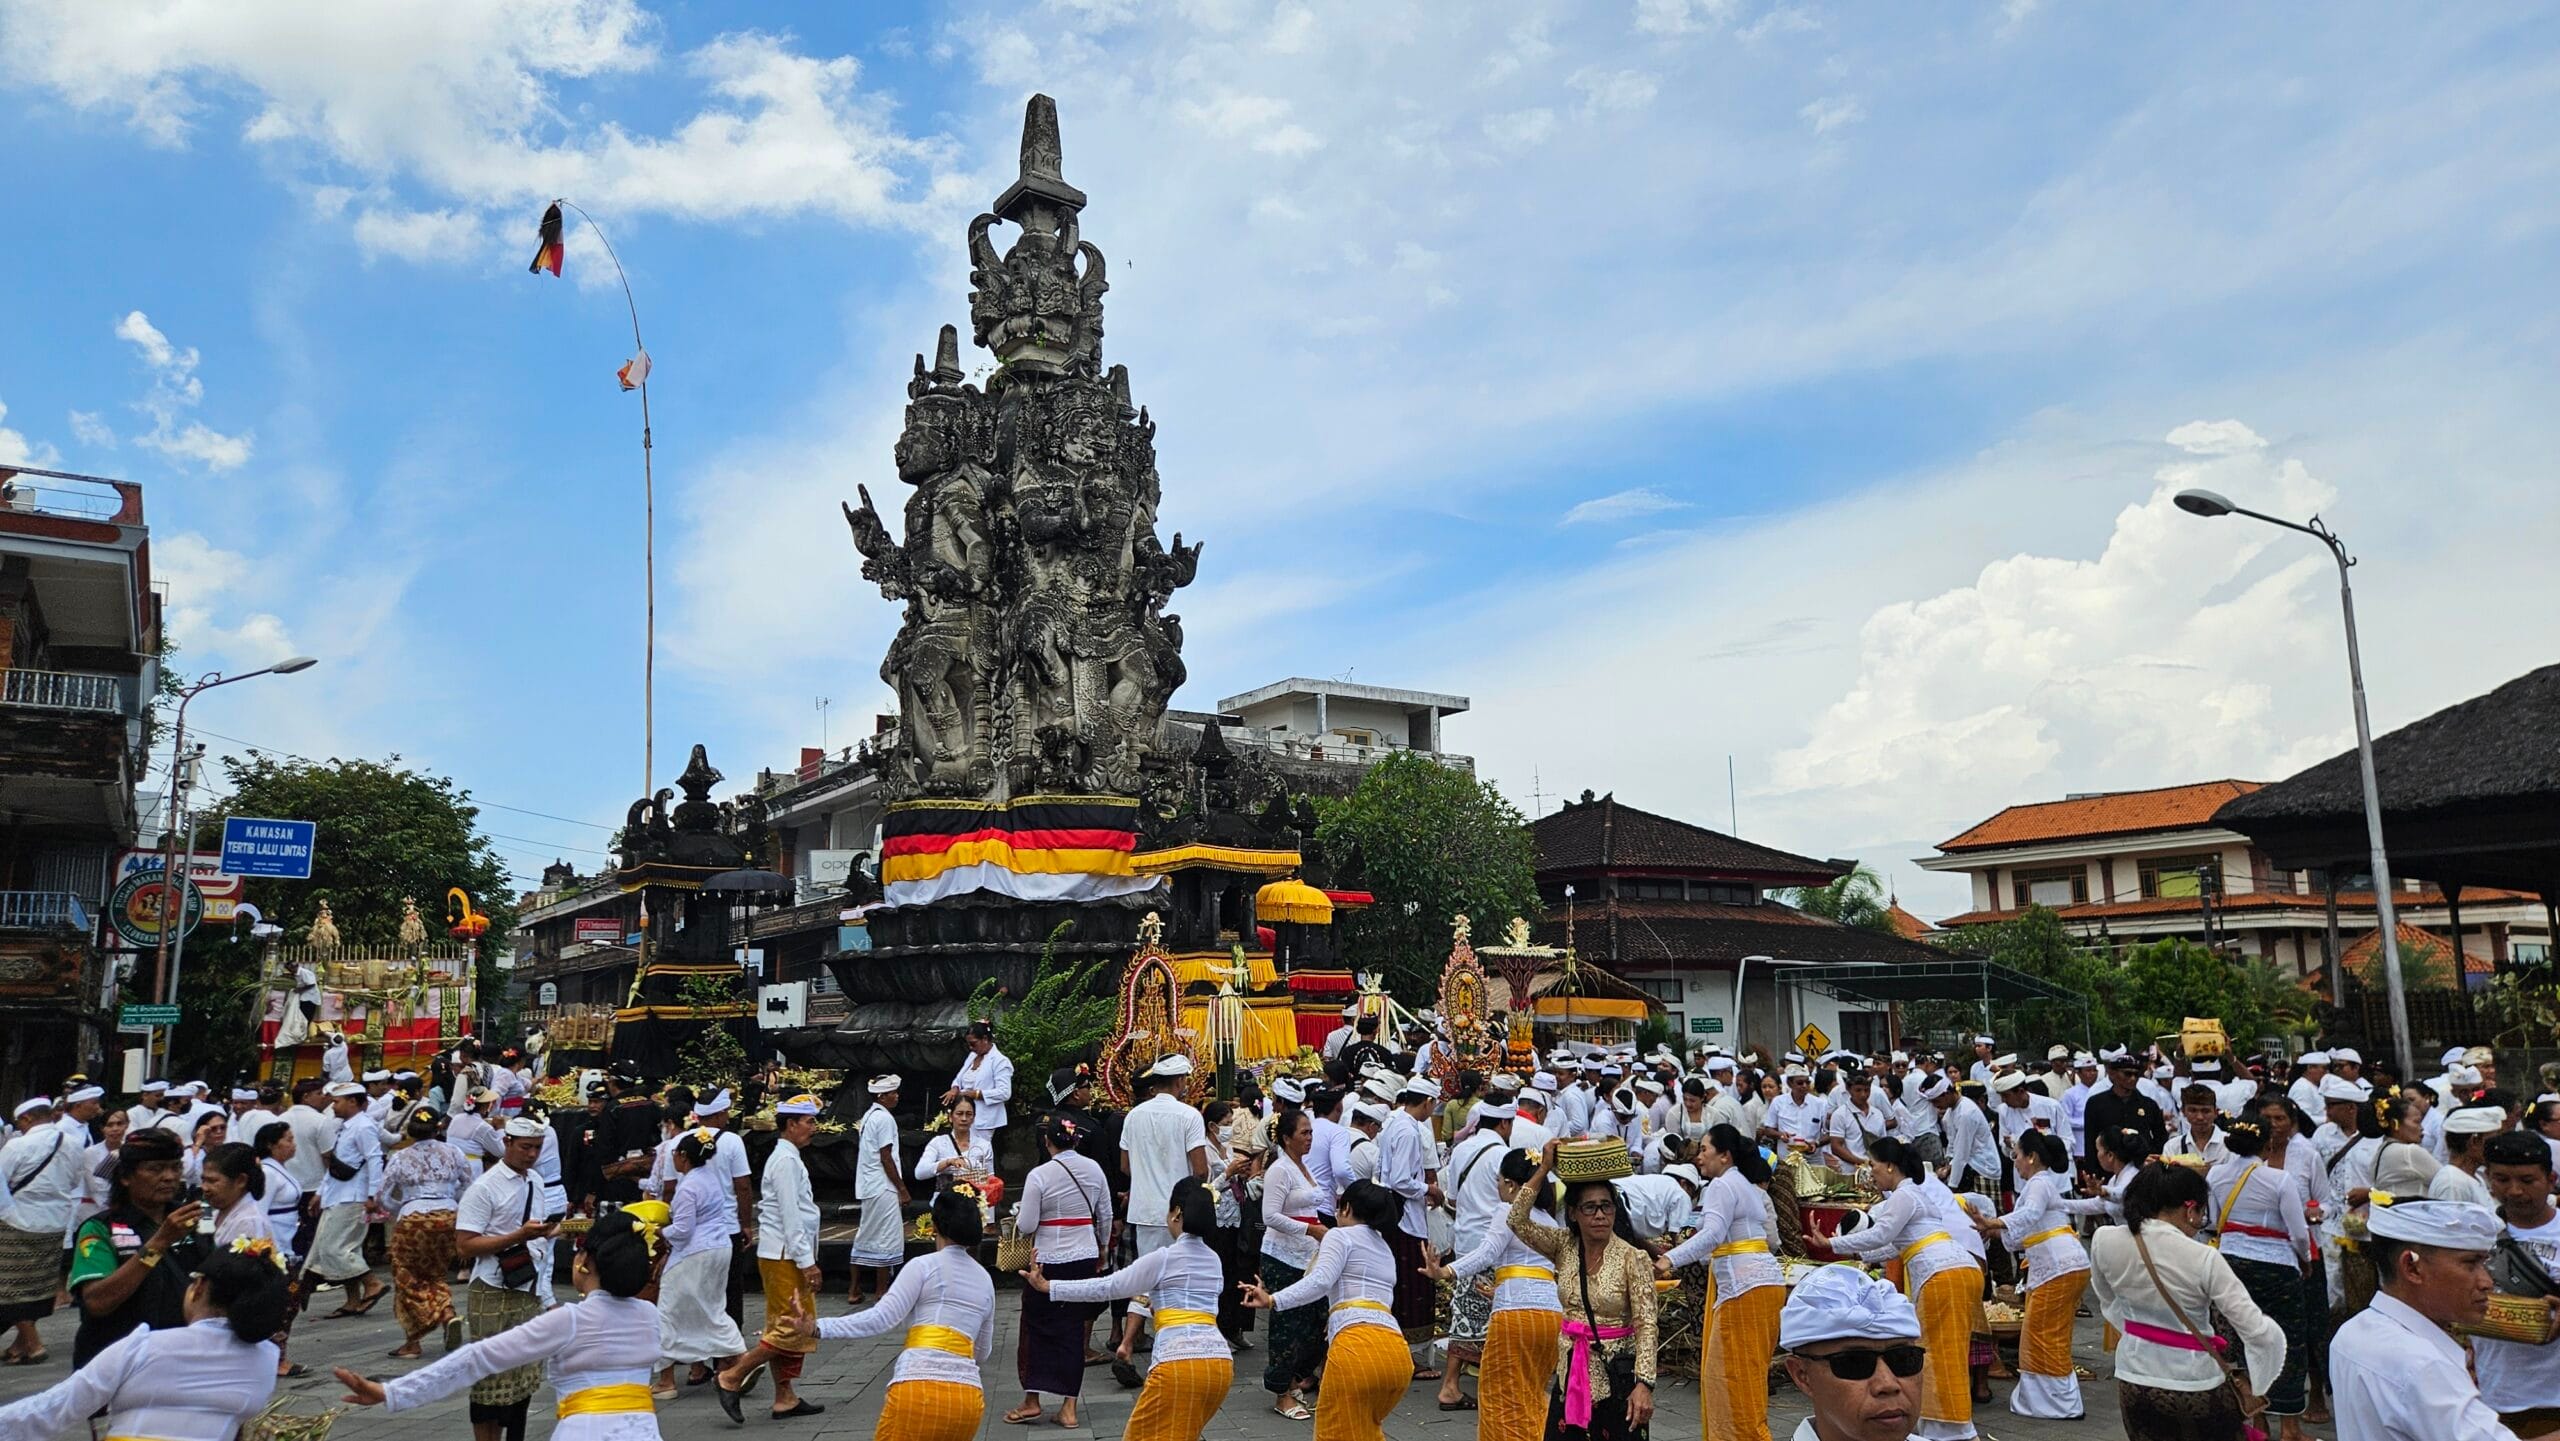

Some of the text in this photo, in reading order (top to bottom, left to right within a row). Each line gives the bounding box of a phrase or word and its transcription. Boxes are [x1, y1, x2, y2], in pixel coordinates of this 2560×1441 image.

[245, 825, 294, 840] KAWASAN
[227, 841, 308, 858] TERTIB LALU LINTAS
